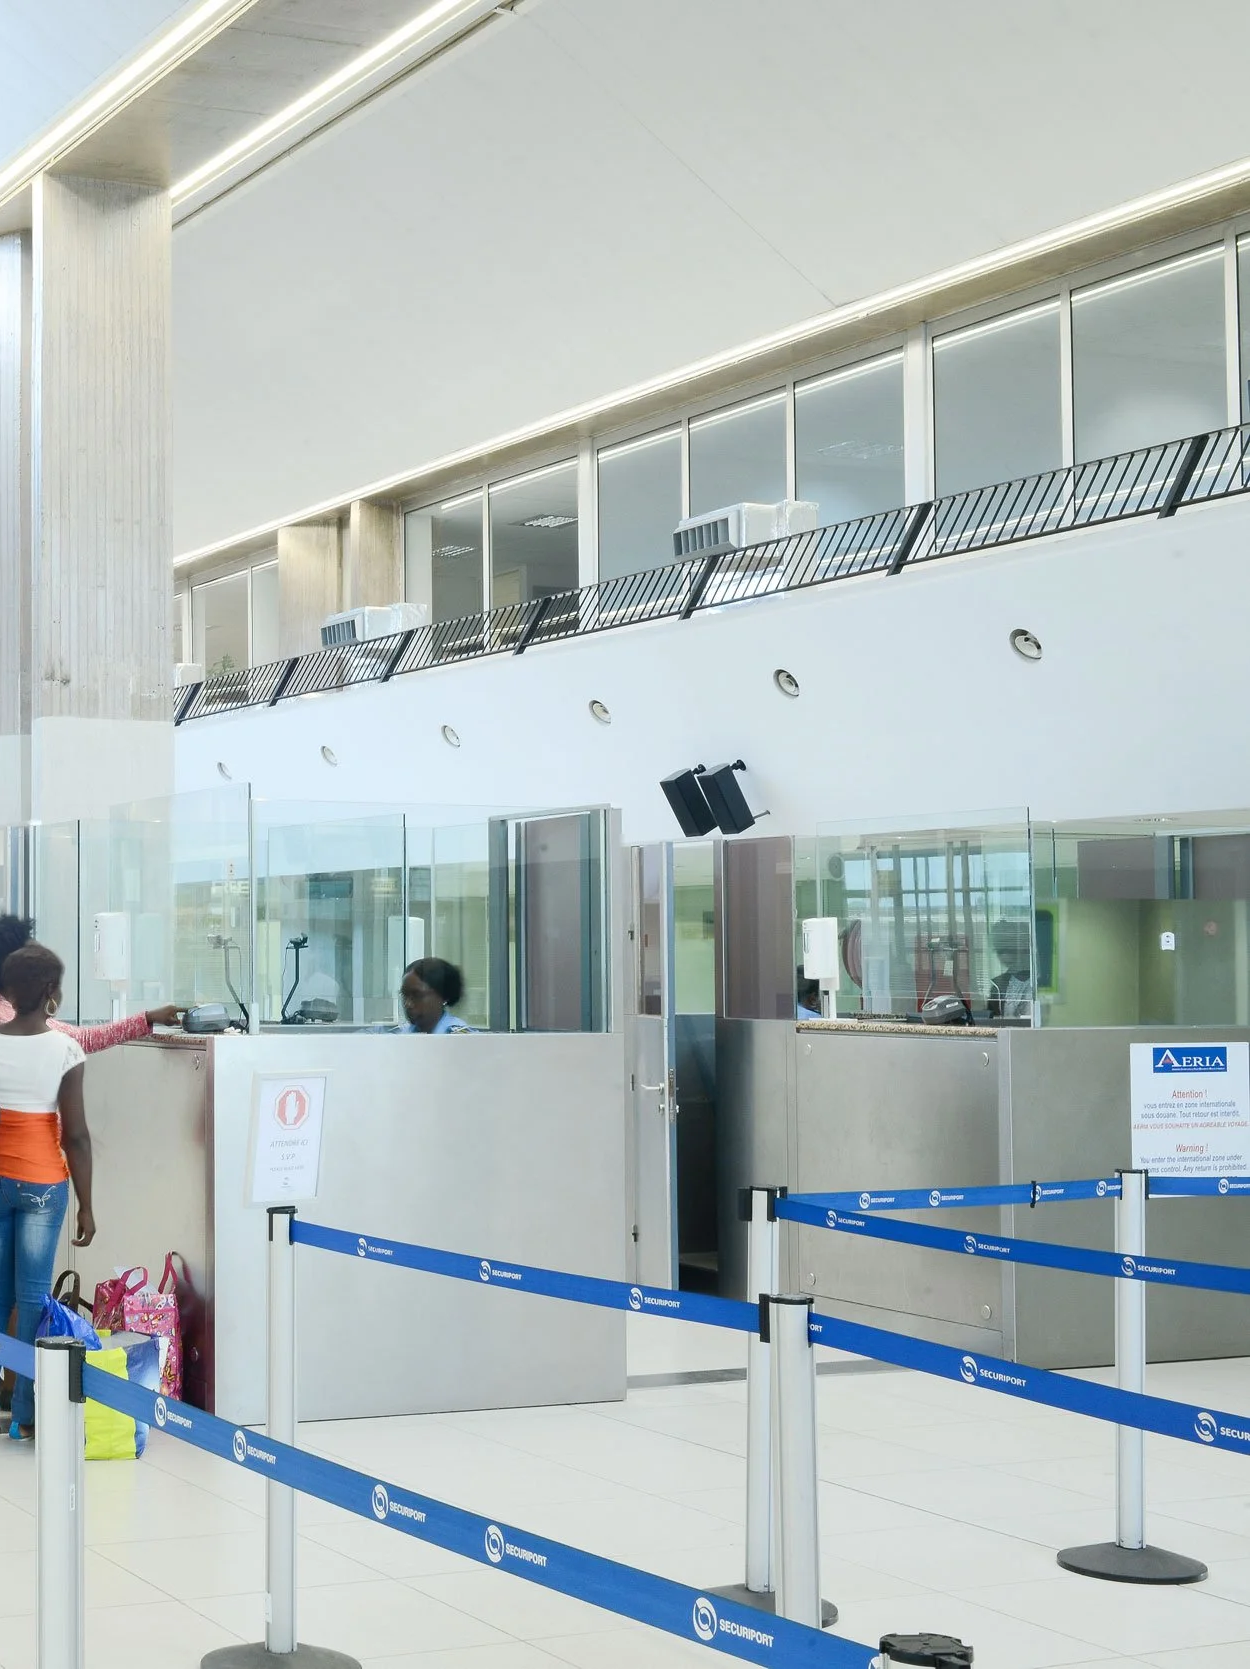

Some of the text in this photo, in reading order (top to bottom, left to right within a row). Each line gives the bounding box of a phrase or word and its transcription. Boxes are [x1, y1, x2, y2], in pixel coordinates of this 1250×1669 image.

[1155, 1049, 1225, 1067] AERIA
[1172, 1089, 1203, 1099] Attention
[1158, 1101, 1175, 1109] entrez
[1176, 1144, 1204, 1154] Warning
[1140, 1156, 1151, 1164] You
[1177, 1155, 1211, 1163] international
[1183, 1165, 1194, 1174] Any
[838, 1217, 866, 1227] SECURIPORT
[368, 1245, 393, 1256] SECURIPORT
[978, 1243, 1011, 1254] SECURIPORT
[492, 1269, 522, 1280] SECURIPORT
[1138, 1264, 1177, 1276] SECURIPORT
[644, 1296, 681, 1309] SECURIPORT
[979, 1368, 1027, 1387] SECURIPORT
[167, 1411, 193, 1429] SECURIPORT
[247, 1445, 277, 1465] SECURIPORT
[389, 1501, 427, 1523] SECURIPORT
[505, 1543, 548, 1567] SECURIPORT
[719, 1619, 774, 1648] SECURIPORT
